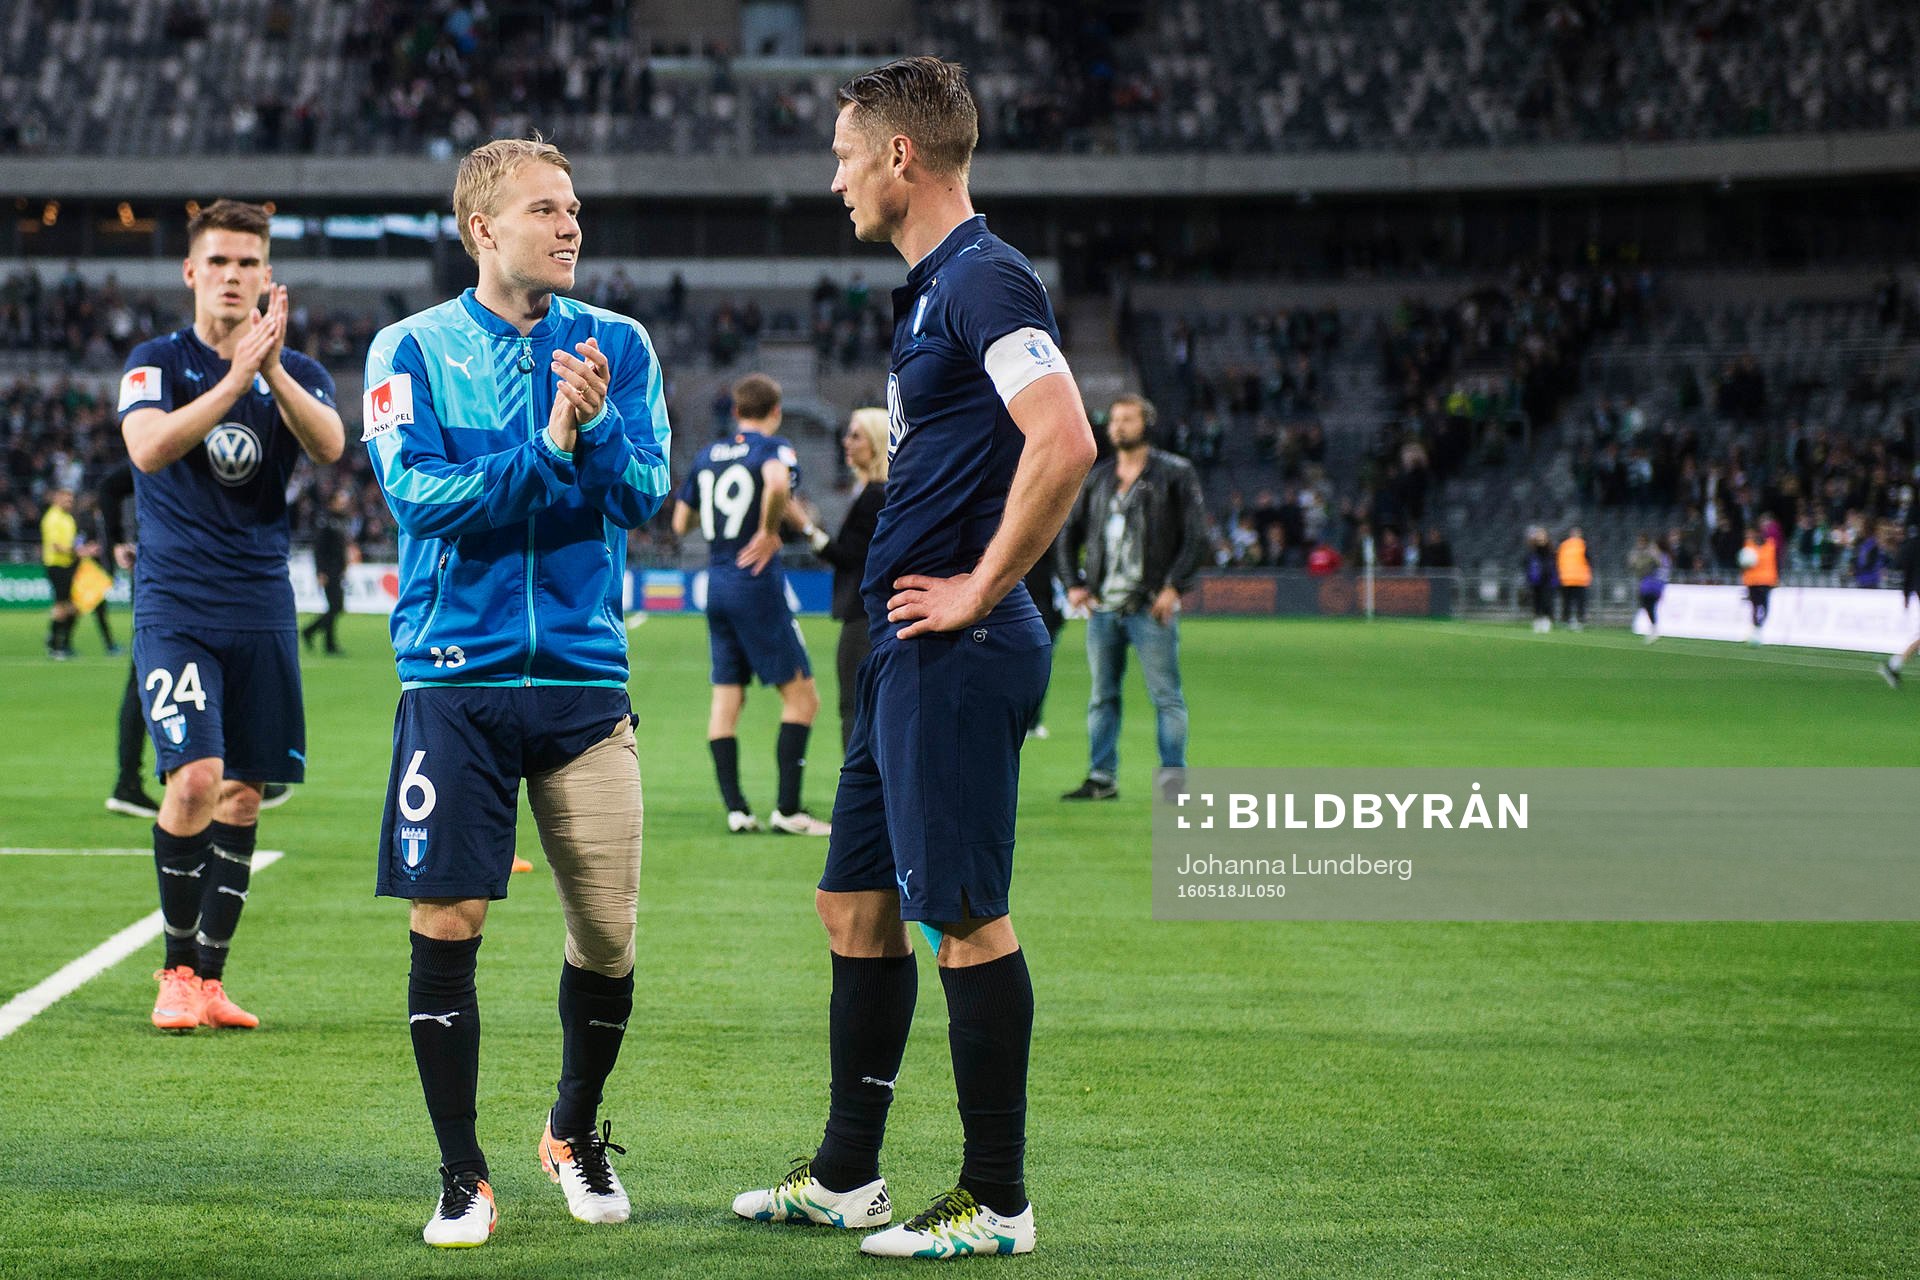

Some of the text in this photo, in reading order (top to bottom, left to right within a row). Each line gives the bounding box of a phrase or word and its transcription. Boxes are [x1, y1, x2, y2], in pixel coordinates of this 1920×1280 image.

[697, 464, 755, 541] 19
[145, 662, 207, 721] 24
[399, 749, 436, 822] 6
